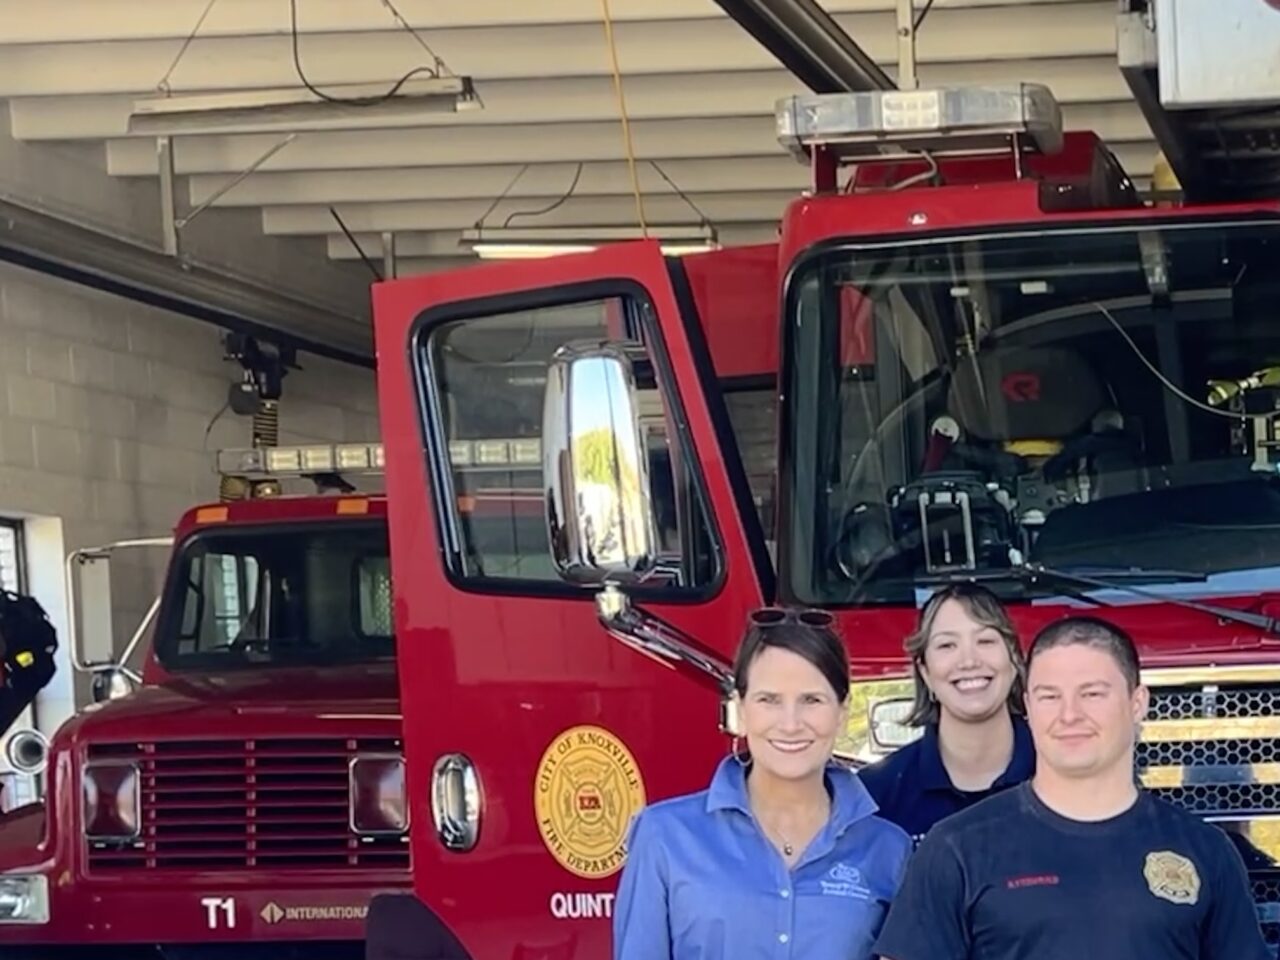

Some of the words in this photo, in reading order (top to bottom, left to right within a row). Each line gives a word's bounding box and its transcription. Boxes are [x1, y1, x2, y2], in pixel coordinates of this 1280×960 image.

[540, 754, 557, 793] CITY
[557, 736, 574, 755] OF
[577, 732, 640, 791] KNOXVILLE
[542, 818, 563, 856] FIRE
[566, 838, 629, 873] DEPARTM
[200, 897, 236, 929] T1
[550, 892, 615, 919] QUINT
